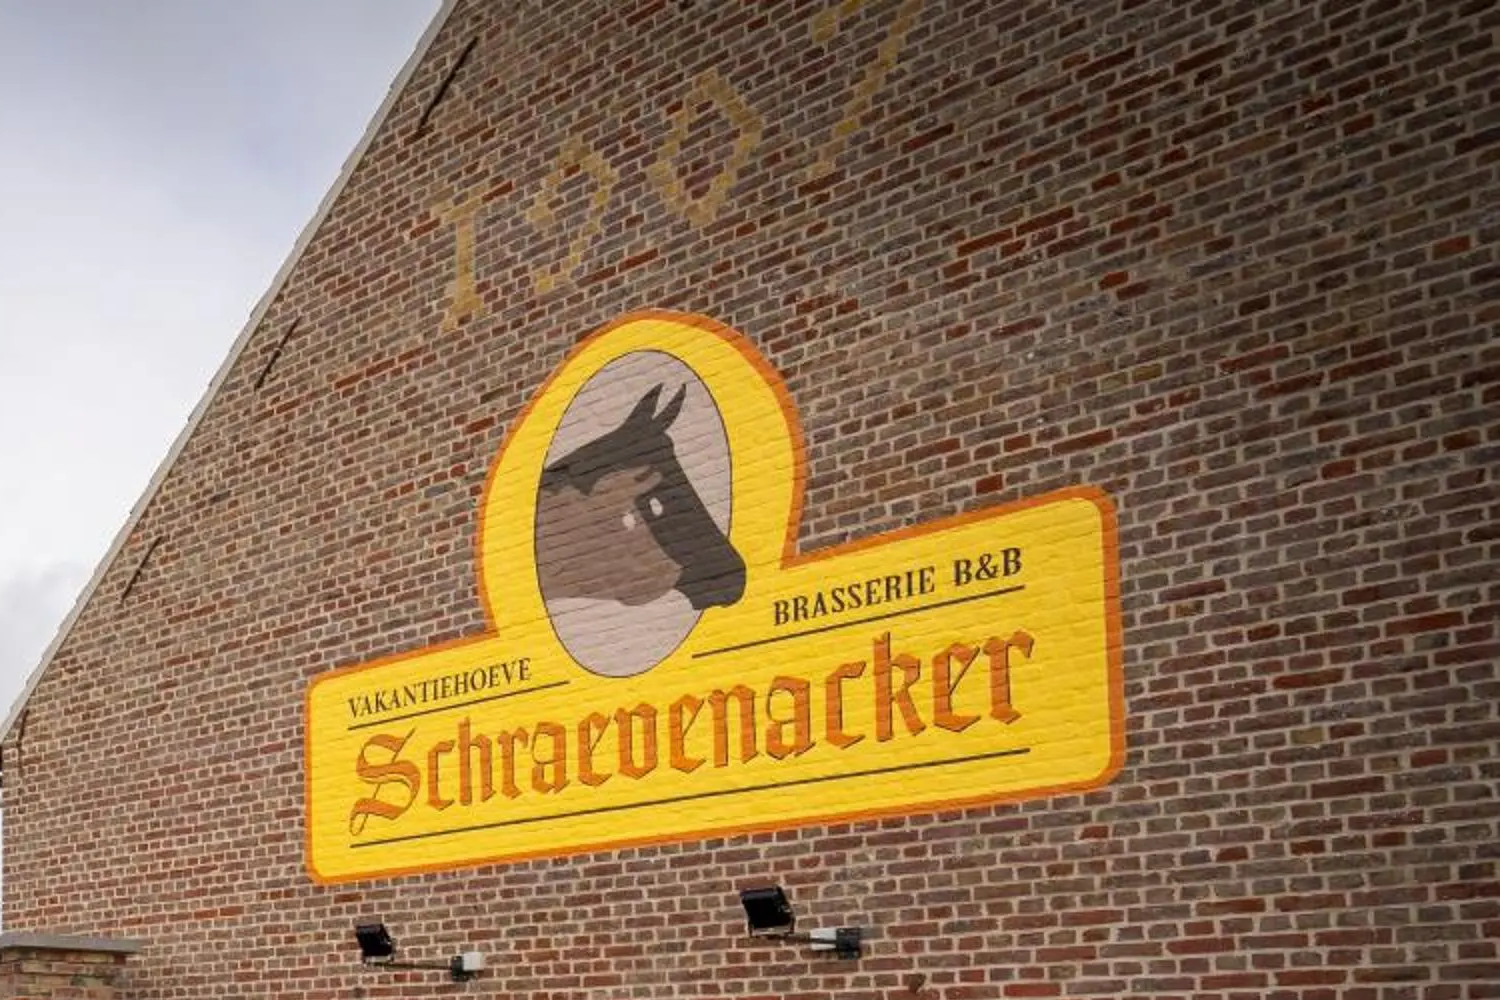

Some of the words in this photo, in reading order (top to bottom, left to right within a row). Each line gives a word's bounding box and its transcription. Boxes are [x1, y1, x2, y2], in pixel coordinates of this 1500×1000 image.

[772, 565, 937, 627] BRASSERIE
[953, 546, 1024, 588] B&B
[347, 656, 532, 719] VAKANTIEHOEVE
[349, 629, 1036, 836] Schraevenacker
